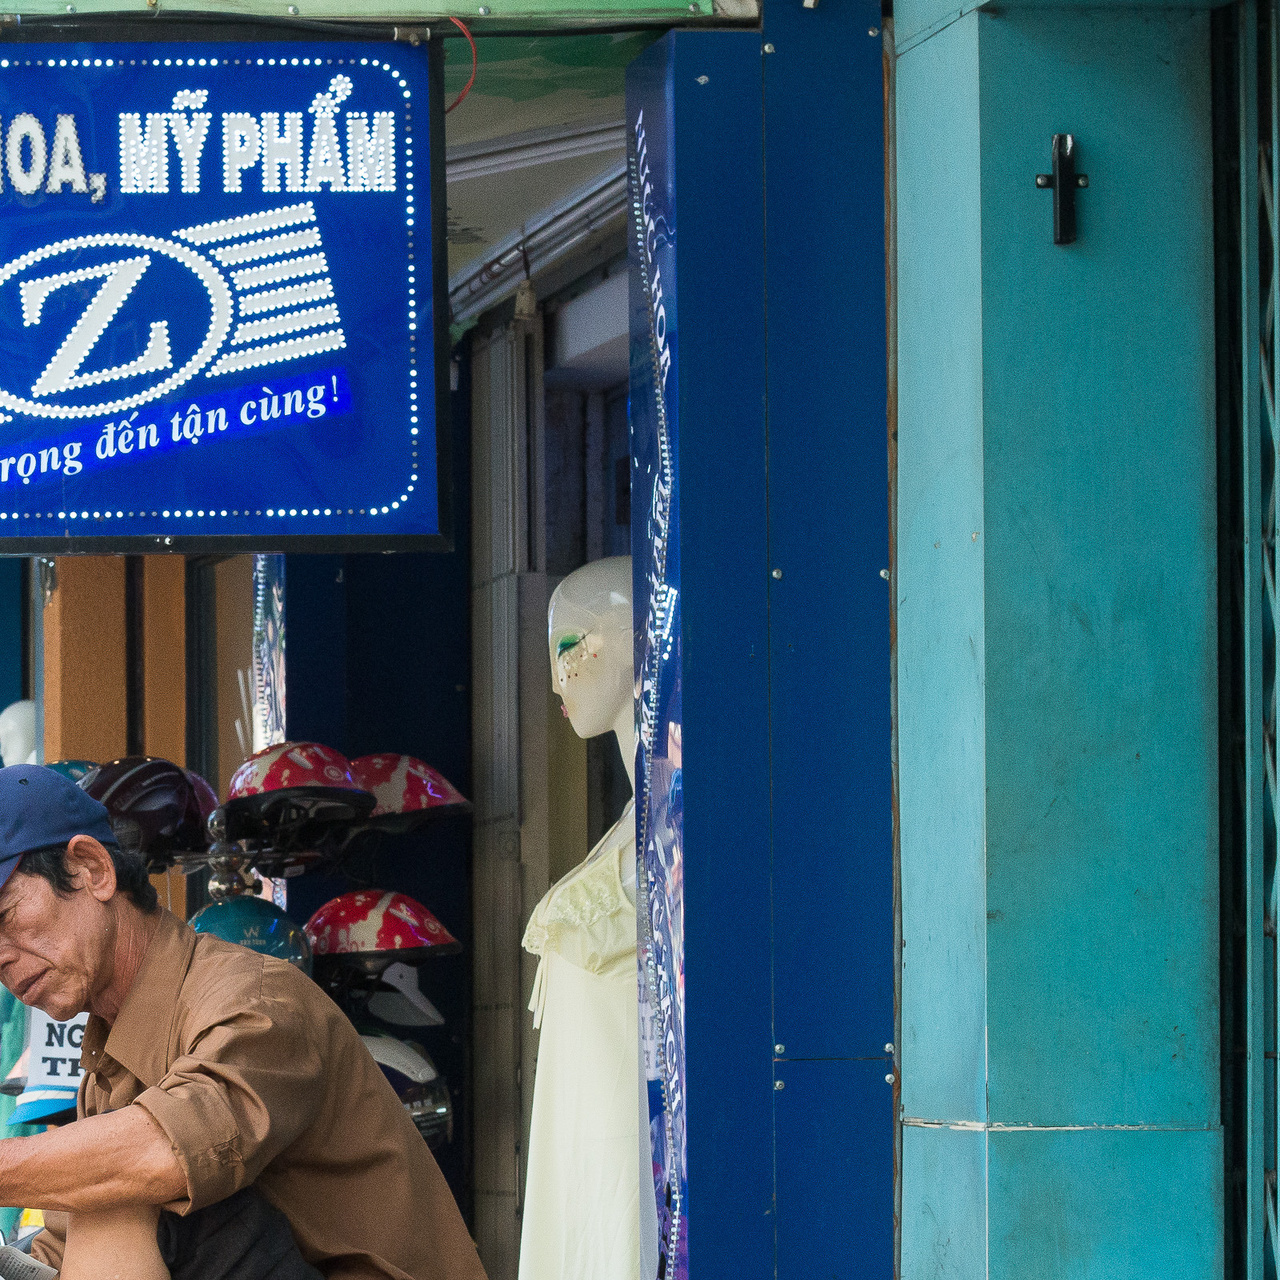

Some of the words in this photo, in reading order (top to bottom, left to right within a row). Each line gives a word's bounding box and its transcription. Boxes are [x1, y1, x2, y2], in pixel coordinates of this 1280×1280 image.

[118, 88, 213, 194] MỸ
[221, 73, 398, 194] PHẨM
[651, 264, 671, 392] HOA
[93, 409, 160, 461] đến
[170, 400, 229, 447] tận
[239, 374, 341, 428] cùng!
[42, 1057, 87, 1077] TH
[45, 1022, 87, 1048] NG
